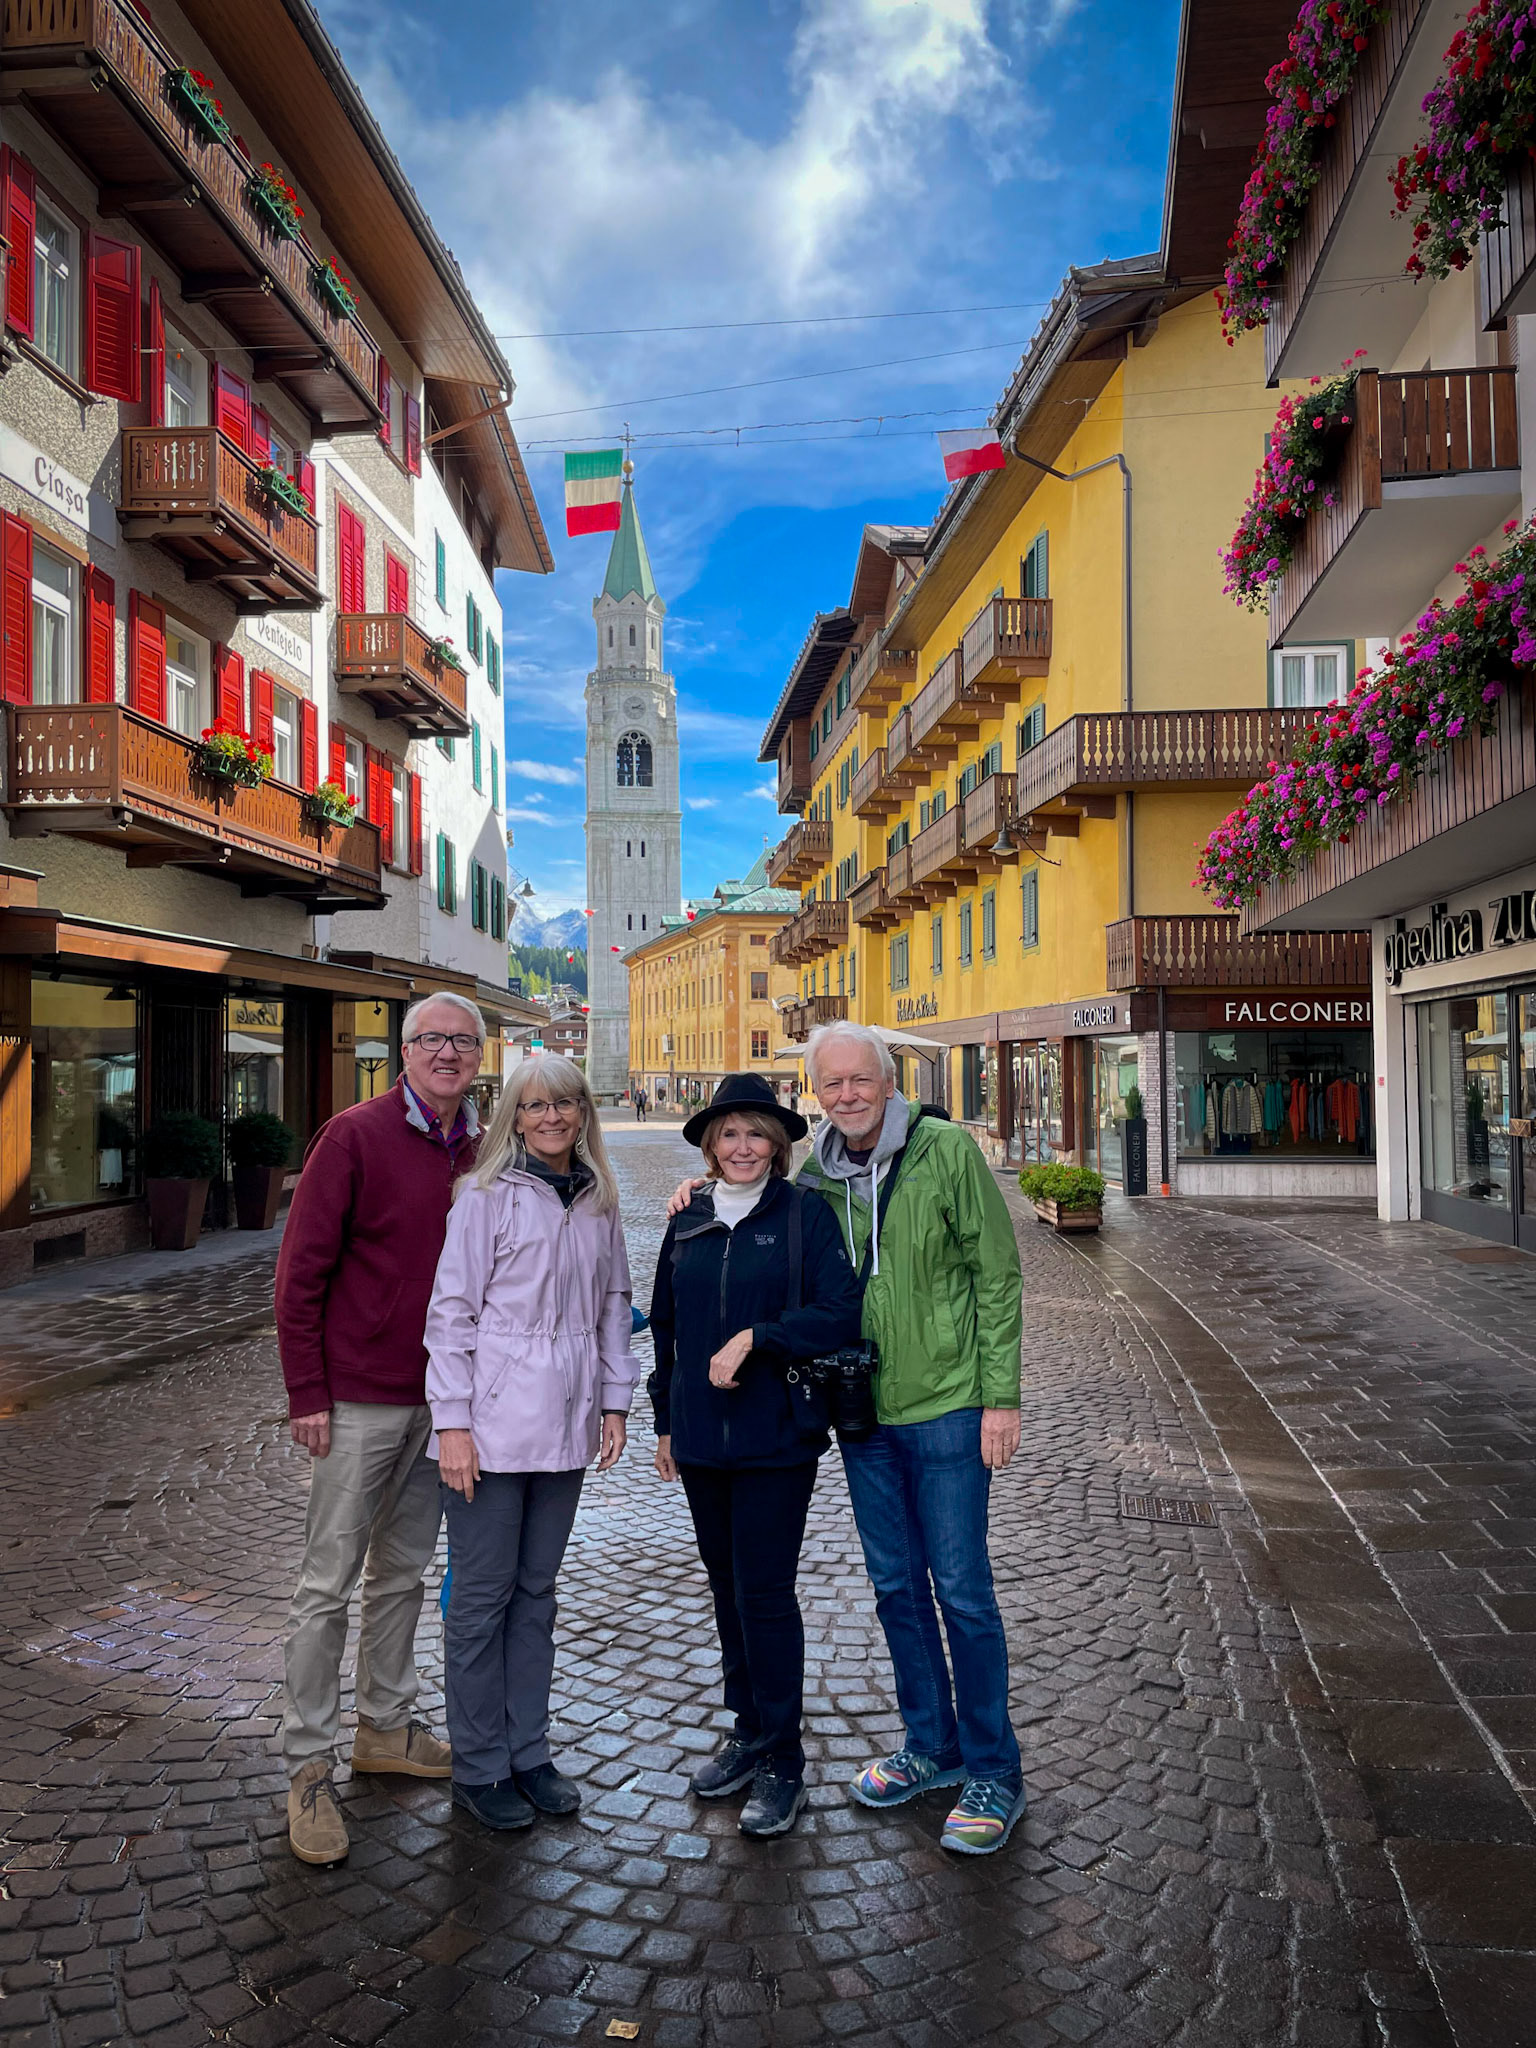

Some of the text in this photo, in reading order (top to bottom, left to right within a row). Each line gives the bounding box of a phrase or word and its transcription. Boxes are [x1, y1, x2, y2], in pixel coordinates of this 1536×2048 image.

[1384, 890, 1536, 986] ghedina zu
[1072, 1005, 1116, 1028] FALCONERI
[1225, 1001, 1371, 1022] FALCONERI
[1132, 1132, 1141, 1183] FALCONERI
